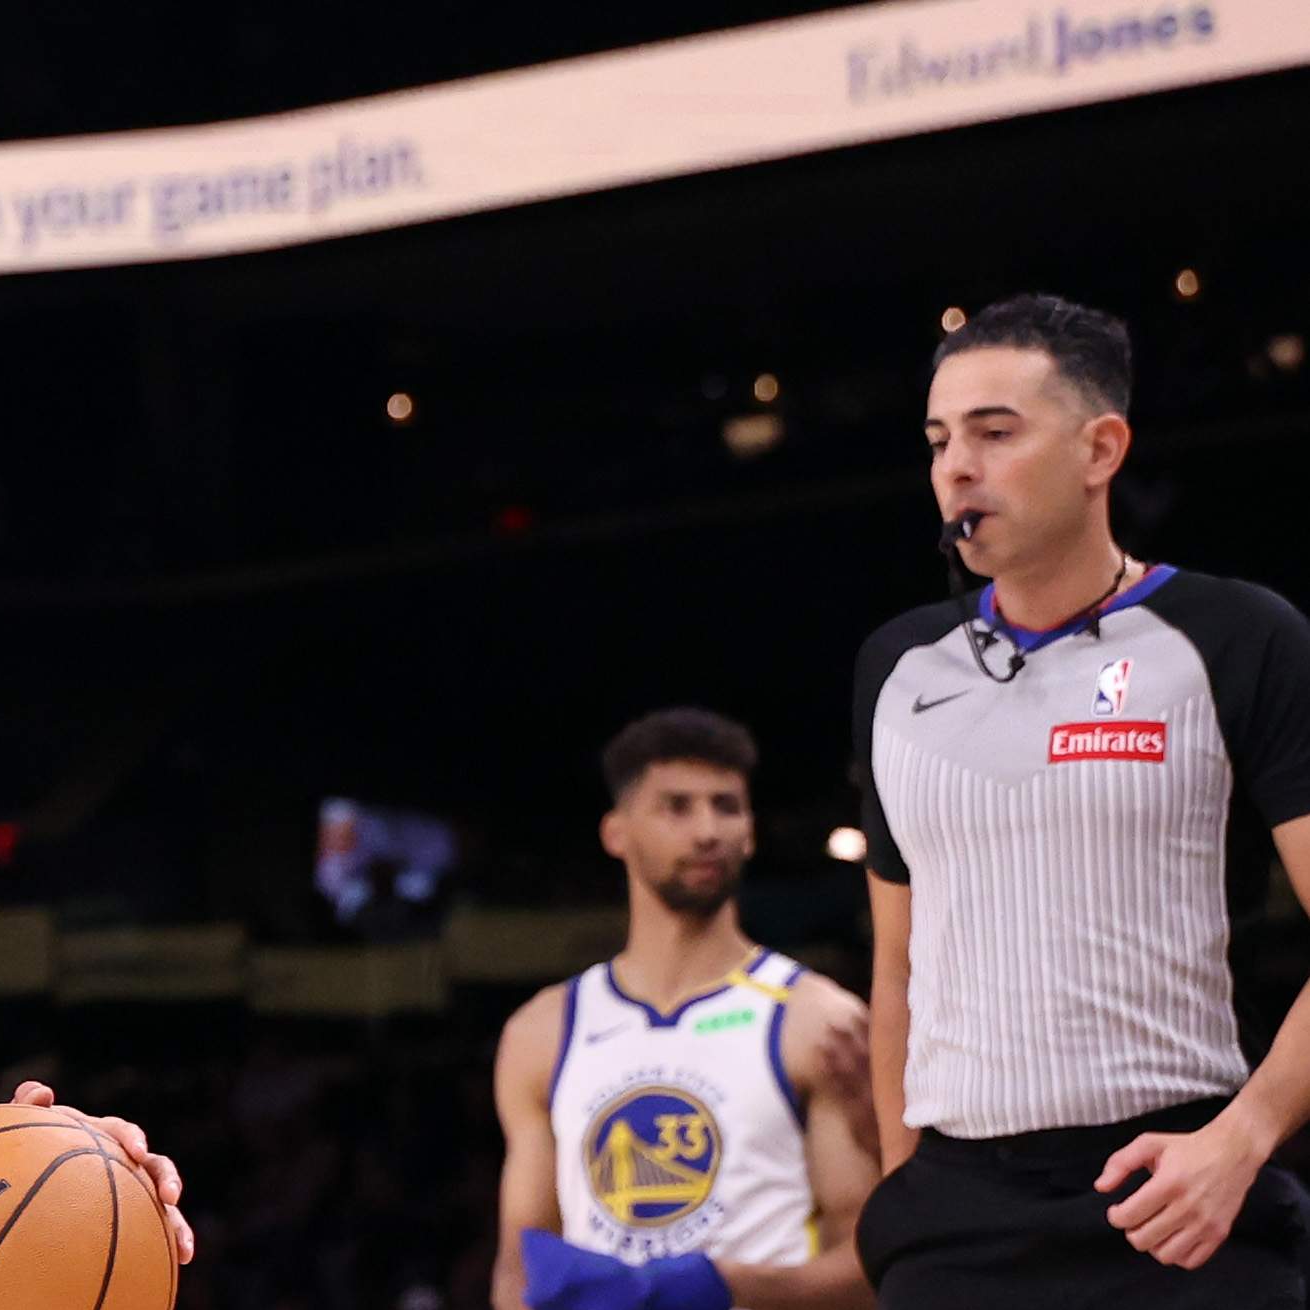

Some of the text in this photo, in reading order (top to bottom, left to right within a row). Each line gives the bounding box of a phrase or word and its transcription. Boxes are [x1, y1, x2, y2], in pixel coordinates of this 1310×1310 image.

[1052, 6, 1214, 74] Jones
[1051, 726, 1163, 756] Emirates
[653, 1113, 711, 1160] 33
